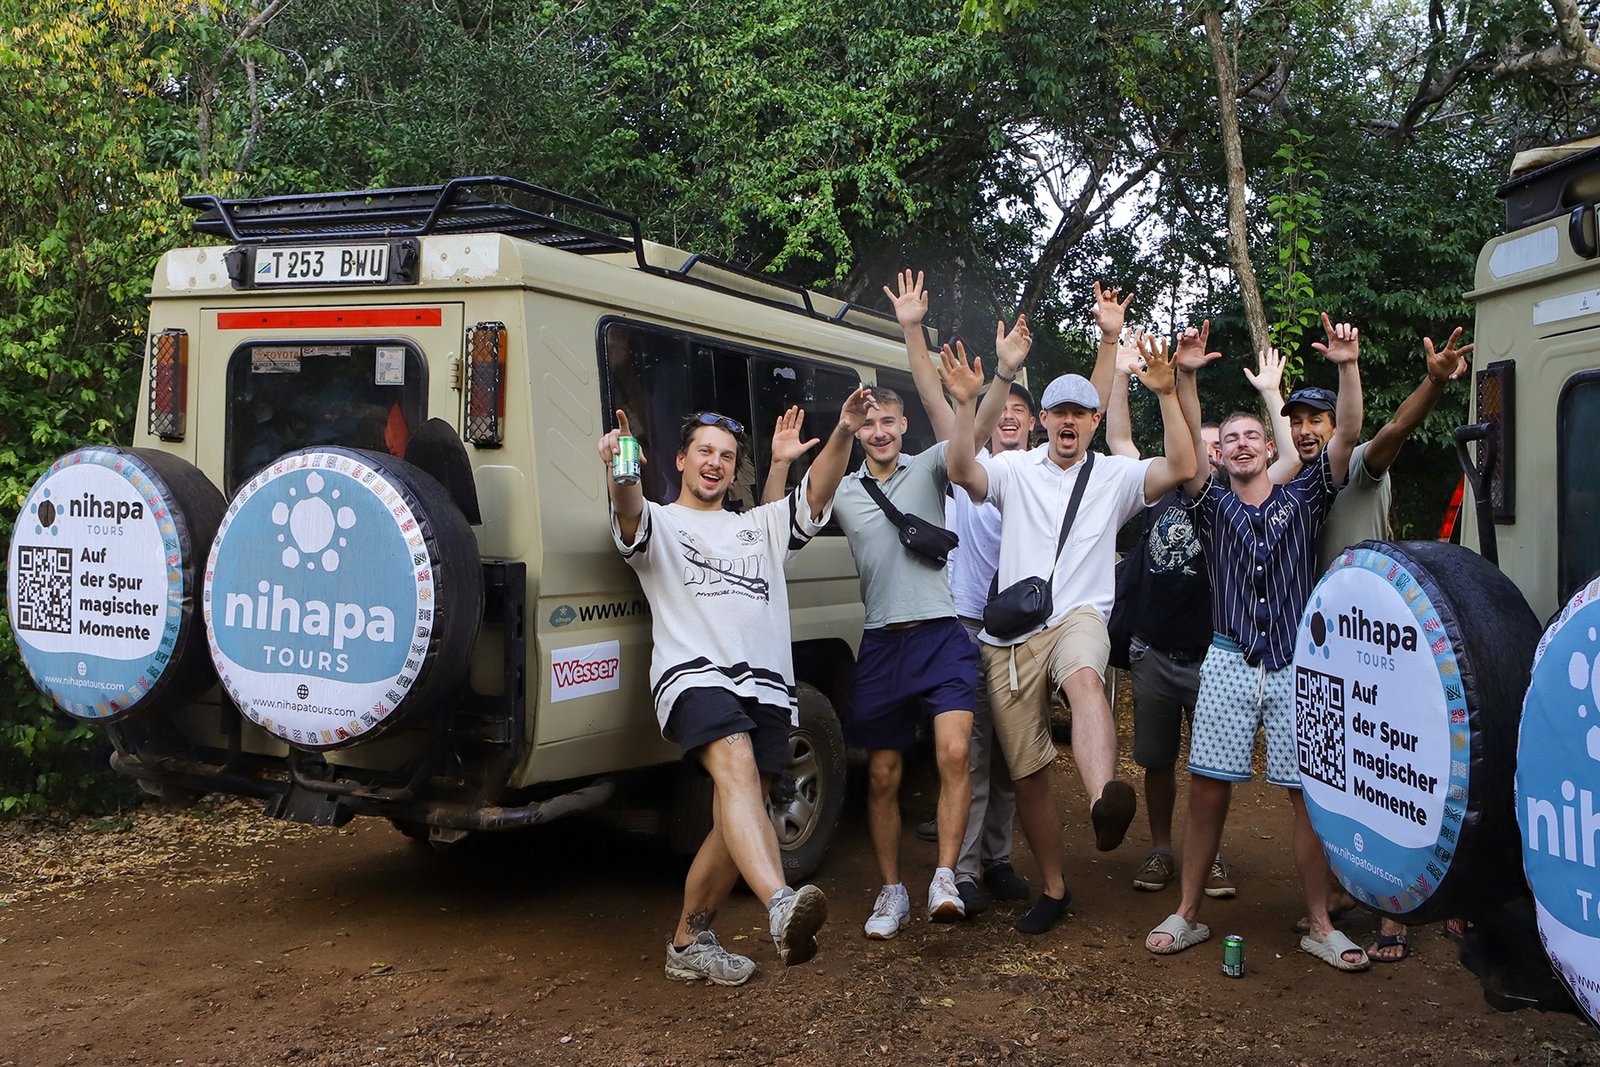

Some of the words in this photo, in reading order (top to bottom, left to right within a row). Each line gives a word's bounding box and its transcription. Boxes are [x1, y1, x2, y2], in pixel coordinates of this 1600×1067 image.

[272, 252, 284, 278] T
[287, 250, 325, 278] 253
[340, 248, 384, 277] BWU
[265, 350, 299, 360] TOYOTA
[69, 492, 144, 525] nihapa
[87, 524, 124, 536] TOURS
[80, 547, 107, 564] Auf
[80, 571, 105, 588] der
[108, 573, 143, 593] Spur
[79, 595, 159, 617] magischer
[224, 580, 395, 650] nihapa
[79, 619, 151, 641] Momente
[1338, 605, 1418, 656] nihapa
[262, 645, 350, 673] TOURS
[552, 657, 619, 689] Wesser
[1356, 650, 1396, 672] TOURS
[44, 675, 125, 692] www.nihapatours.com
[1352, 680, 1378, 706] Auf
[252, 697, 356, 718] www.nihapatours.com
[1352, 712, 1377, 739] der
[1379, 721, 1419, 753] Spur
[1352, 747, 1438, 795] magischer
[1353, 775, 1428, 827] Momente
[1323, 839, 1404, 888] www.nihapatours.com
[1576, 888, 1600, 921] T
